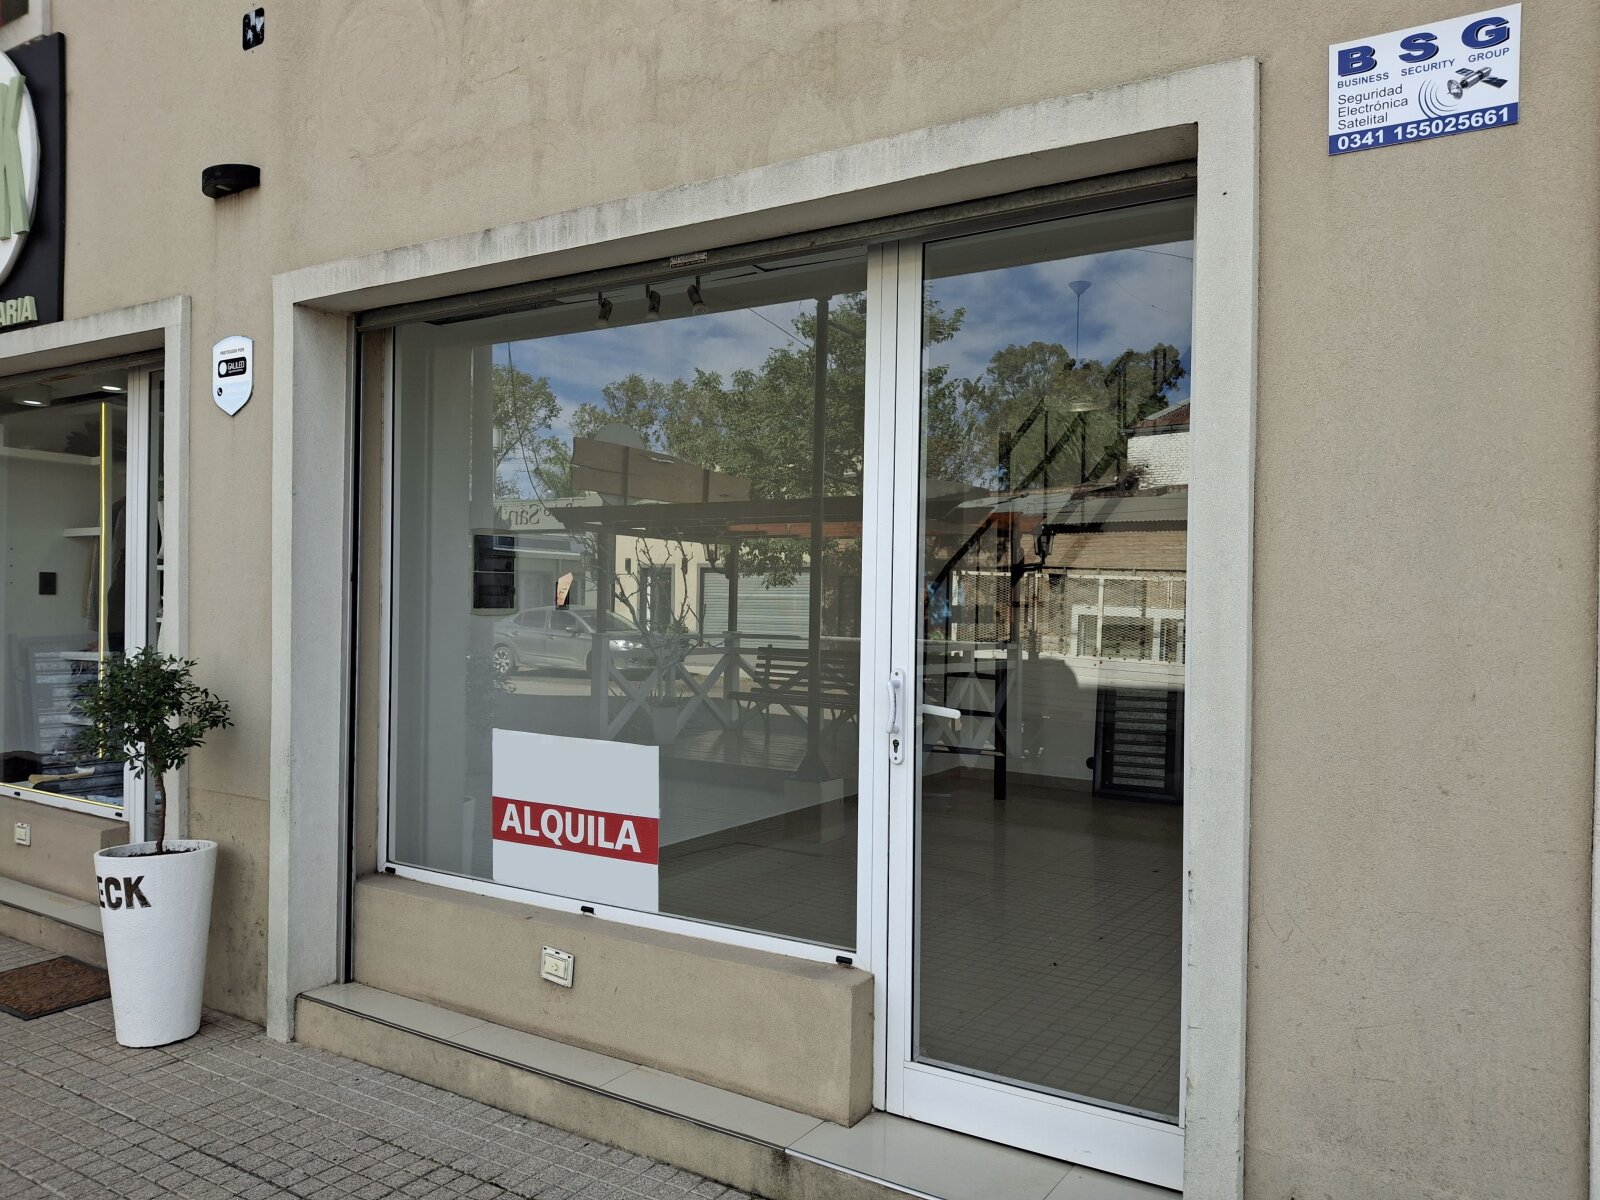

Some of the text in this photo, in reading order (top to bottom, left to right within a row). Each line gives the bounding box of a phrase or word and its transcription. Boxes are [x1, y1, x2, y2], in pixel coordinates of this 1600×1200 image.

[1338, 16, 1510, 77] B S G
[1337, 47, 1510, 88] BUSINESS SECURITY GROUP
[1338, 84, 1403, 105] Seguridad
[1338, 97, 1408, 117] Electrónica
[1337, 112, 1388, 130] Satelital
[1337, 107, 1509, 150] 0341 155025661
[501, 803, 641, 853] ALQUILA
